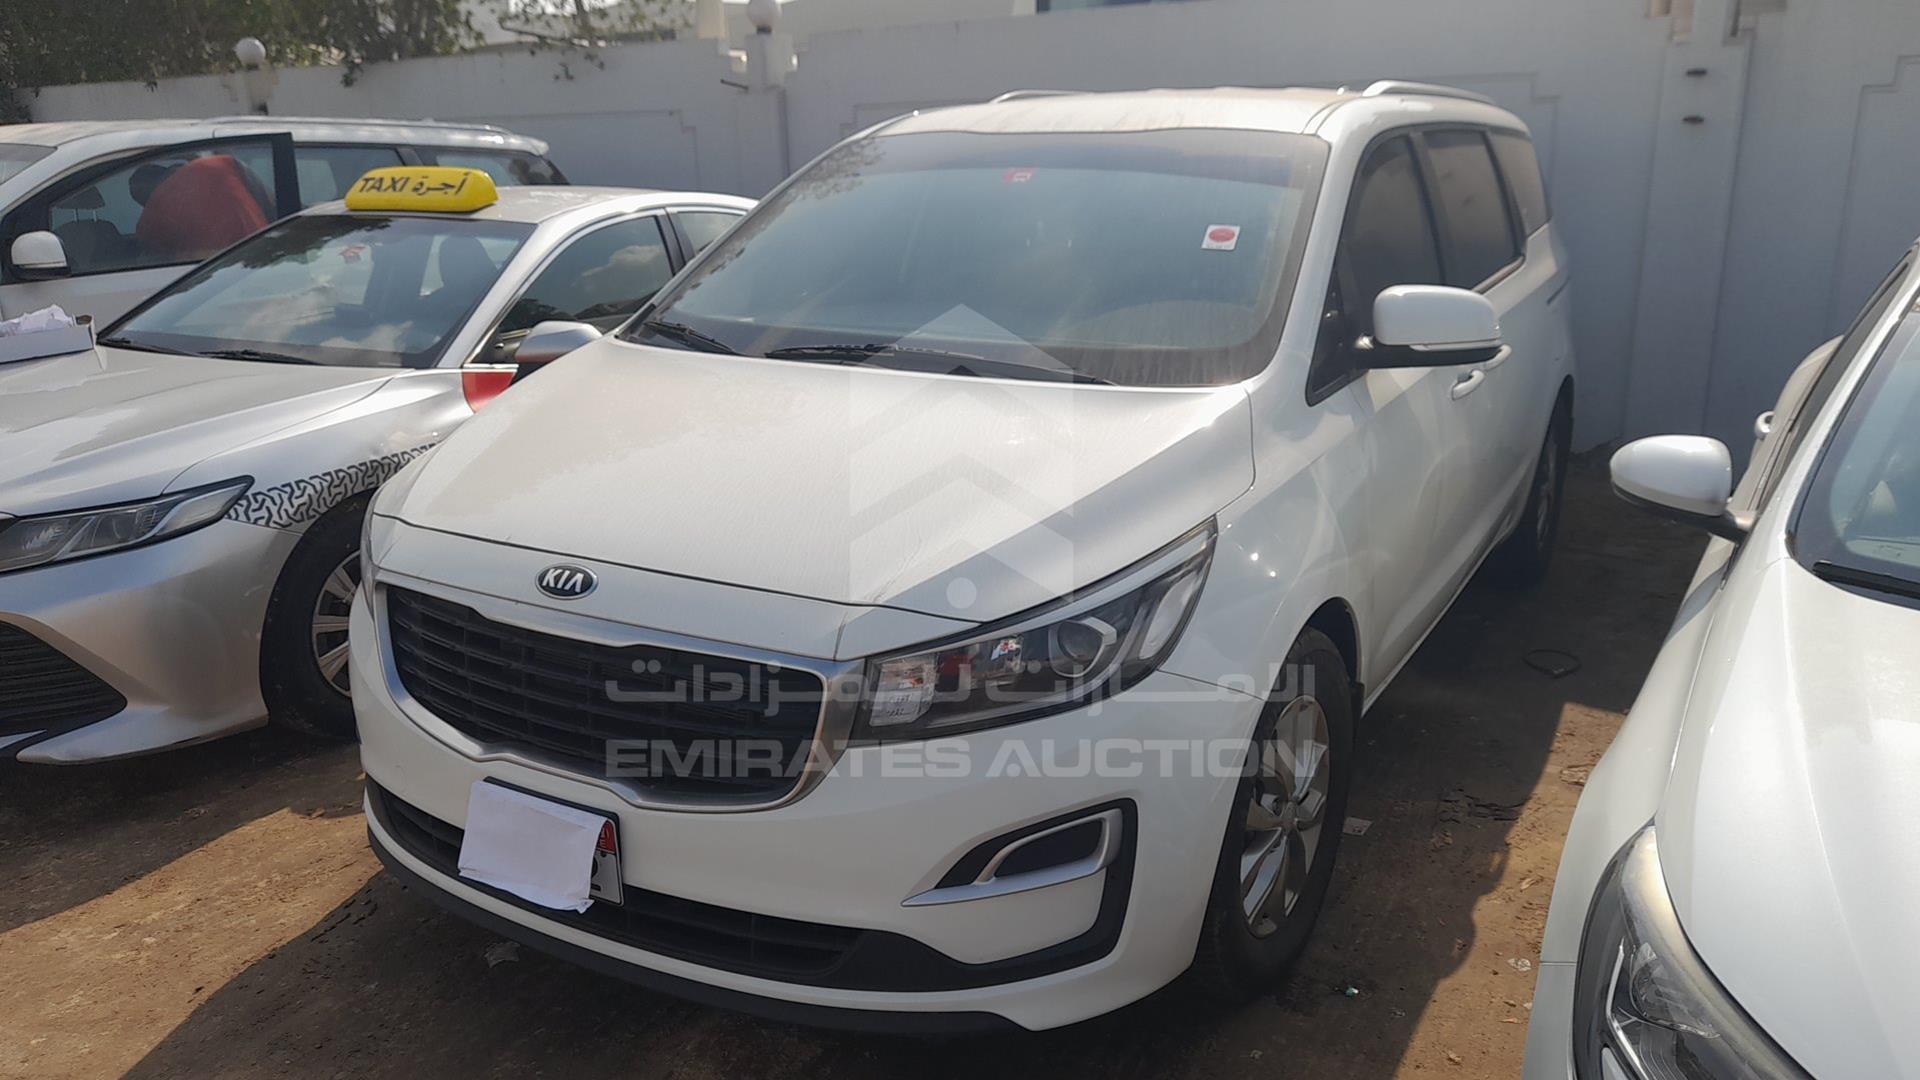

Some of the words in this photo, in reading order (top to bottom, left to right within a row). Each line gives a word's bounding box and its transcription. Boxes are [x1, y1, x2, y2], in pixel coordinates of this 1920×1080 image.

[359, 176, 410, 193] TAXI
[413, 172, 471, 196] أجرة
[541, 568, 585, 593] KIA
